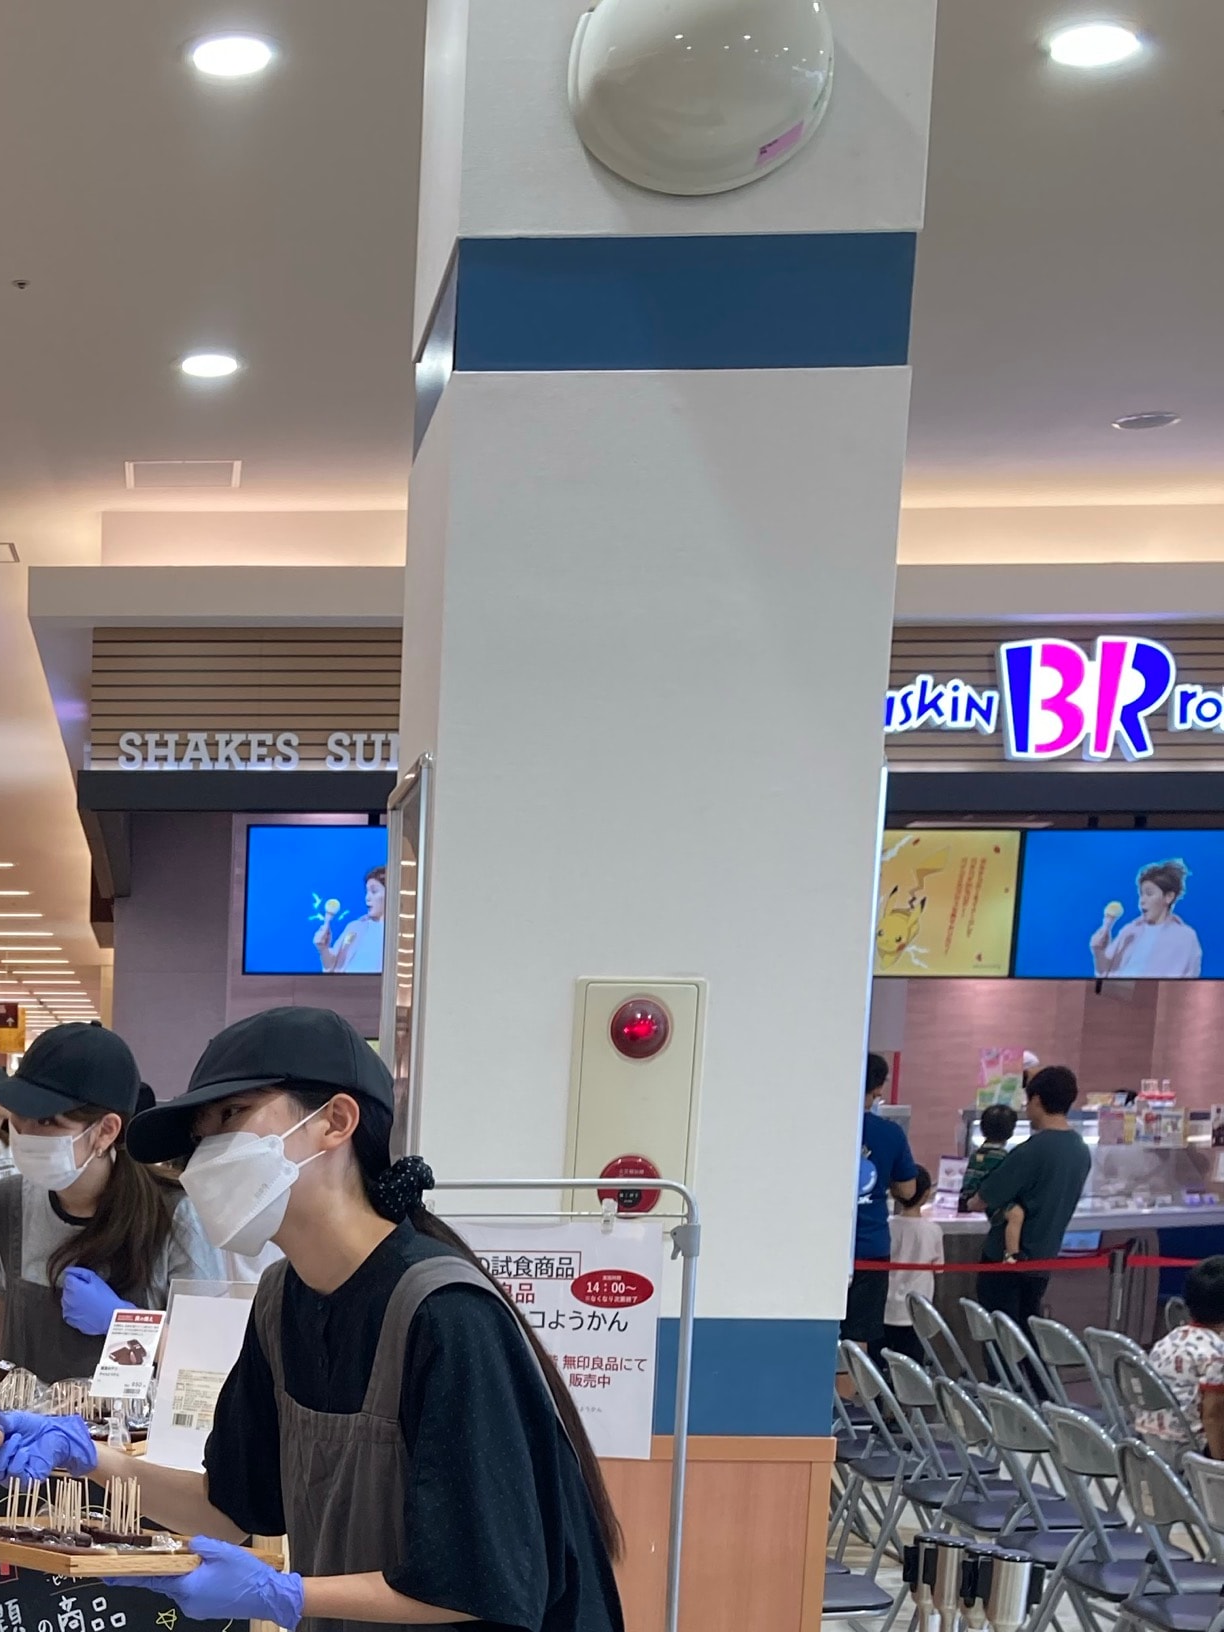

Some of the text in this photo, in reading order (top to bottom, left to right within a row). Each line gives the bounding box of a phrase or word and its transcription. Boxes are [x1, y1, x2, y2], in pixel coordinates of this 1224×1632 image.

[1002, 636, 1175, 756] BR
[1176, 684, 1224, 729] ro
[117, 731, 300, 770] SHAKES
[562, 1354, 648, 1372] 無印良品にて
[569, 1373, 611, 1389] 販売中
